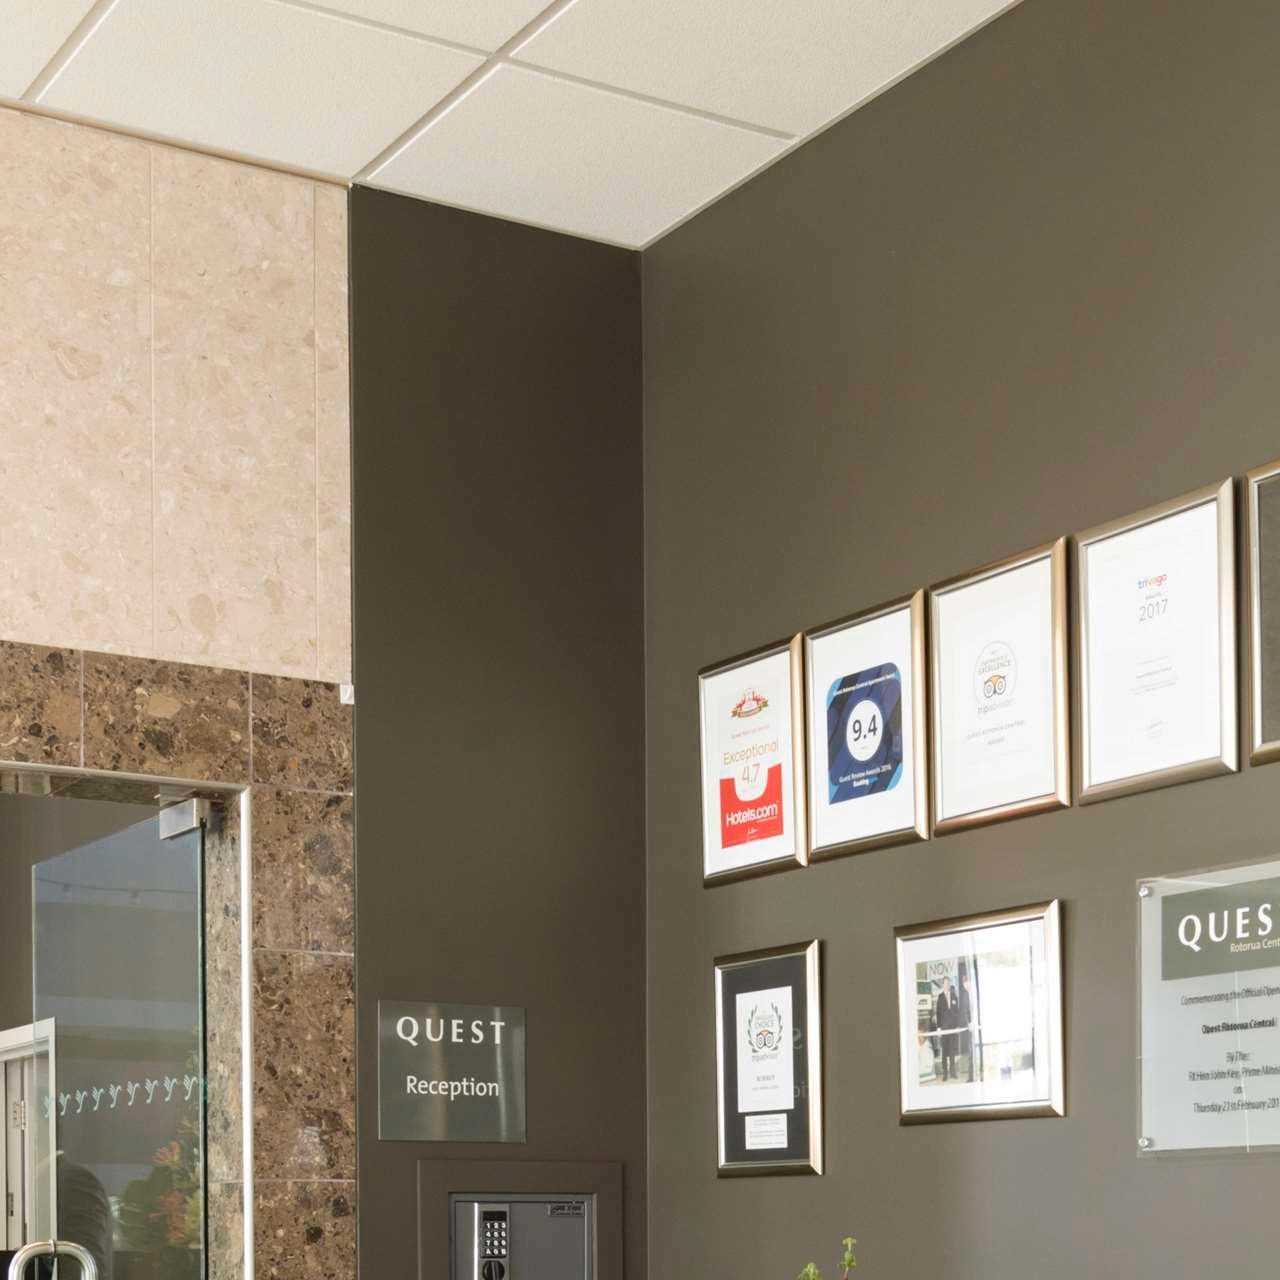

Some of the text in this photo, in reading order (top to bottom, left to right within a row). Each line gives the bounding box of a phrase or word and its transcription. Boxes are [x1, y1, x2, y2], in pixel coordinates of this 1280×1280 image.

[1139, 599, 1168, 621] 2017
[852, 714, 878, 742] 9.4
[723, 737, 780, 766] Exceptional
[741, 763, 761, 784] 4.7
[725, 802, 778, 827] Hotels.com
[1230, 940, 1261, 953] Rotorua
[929, 961, 955, 975] NOW
[396, 1016, 506, 1046] QUEST
[406, 1075, 500, 1101] Reception
